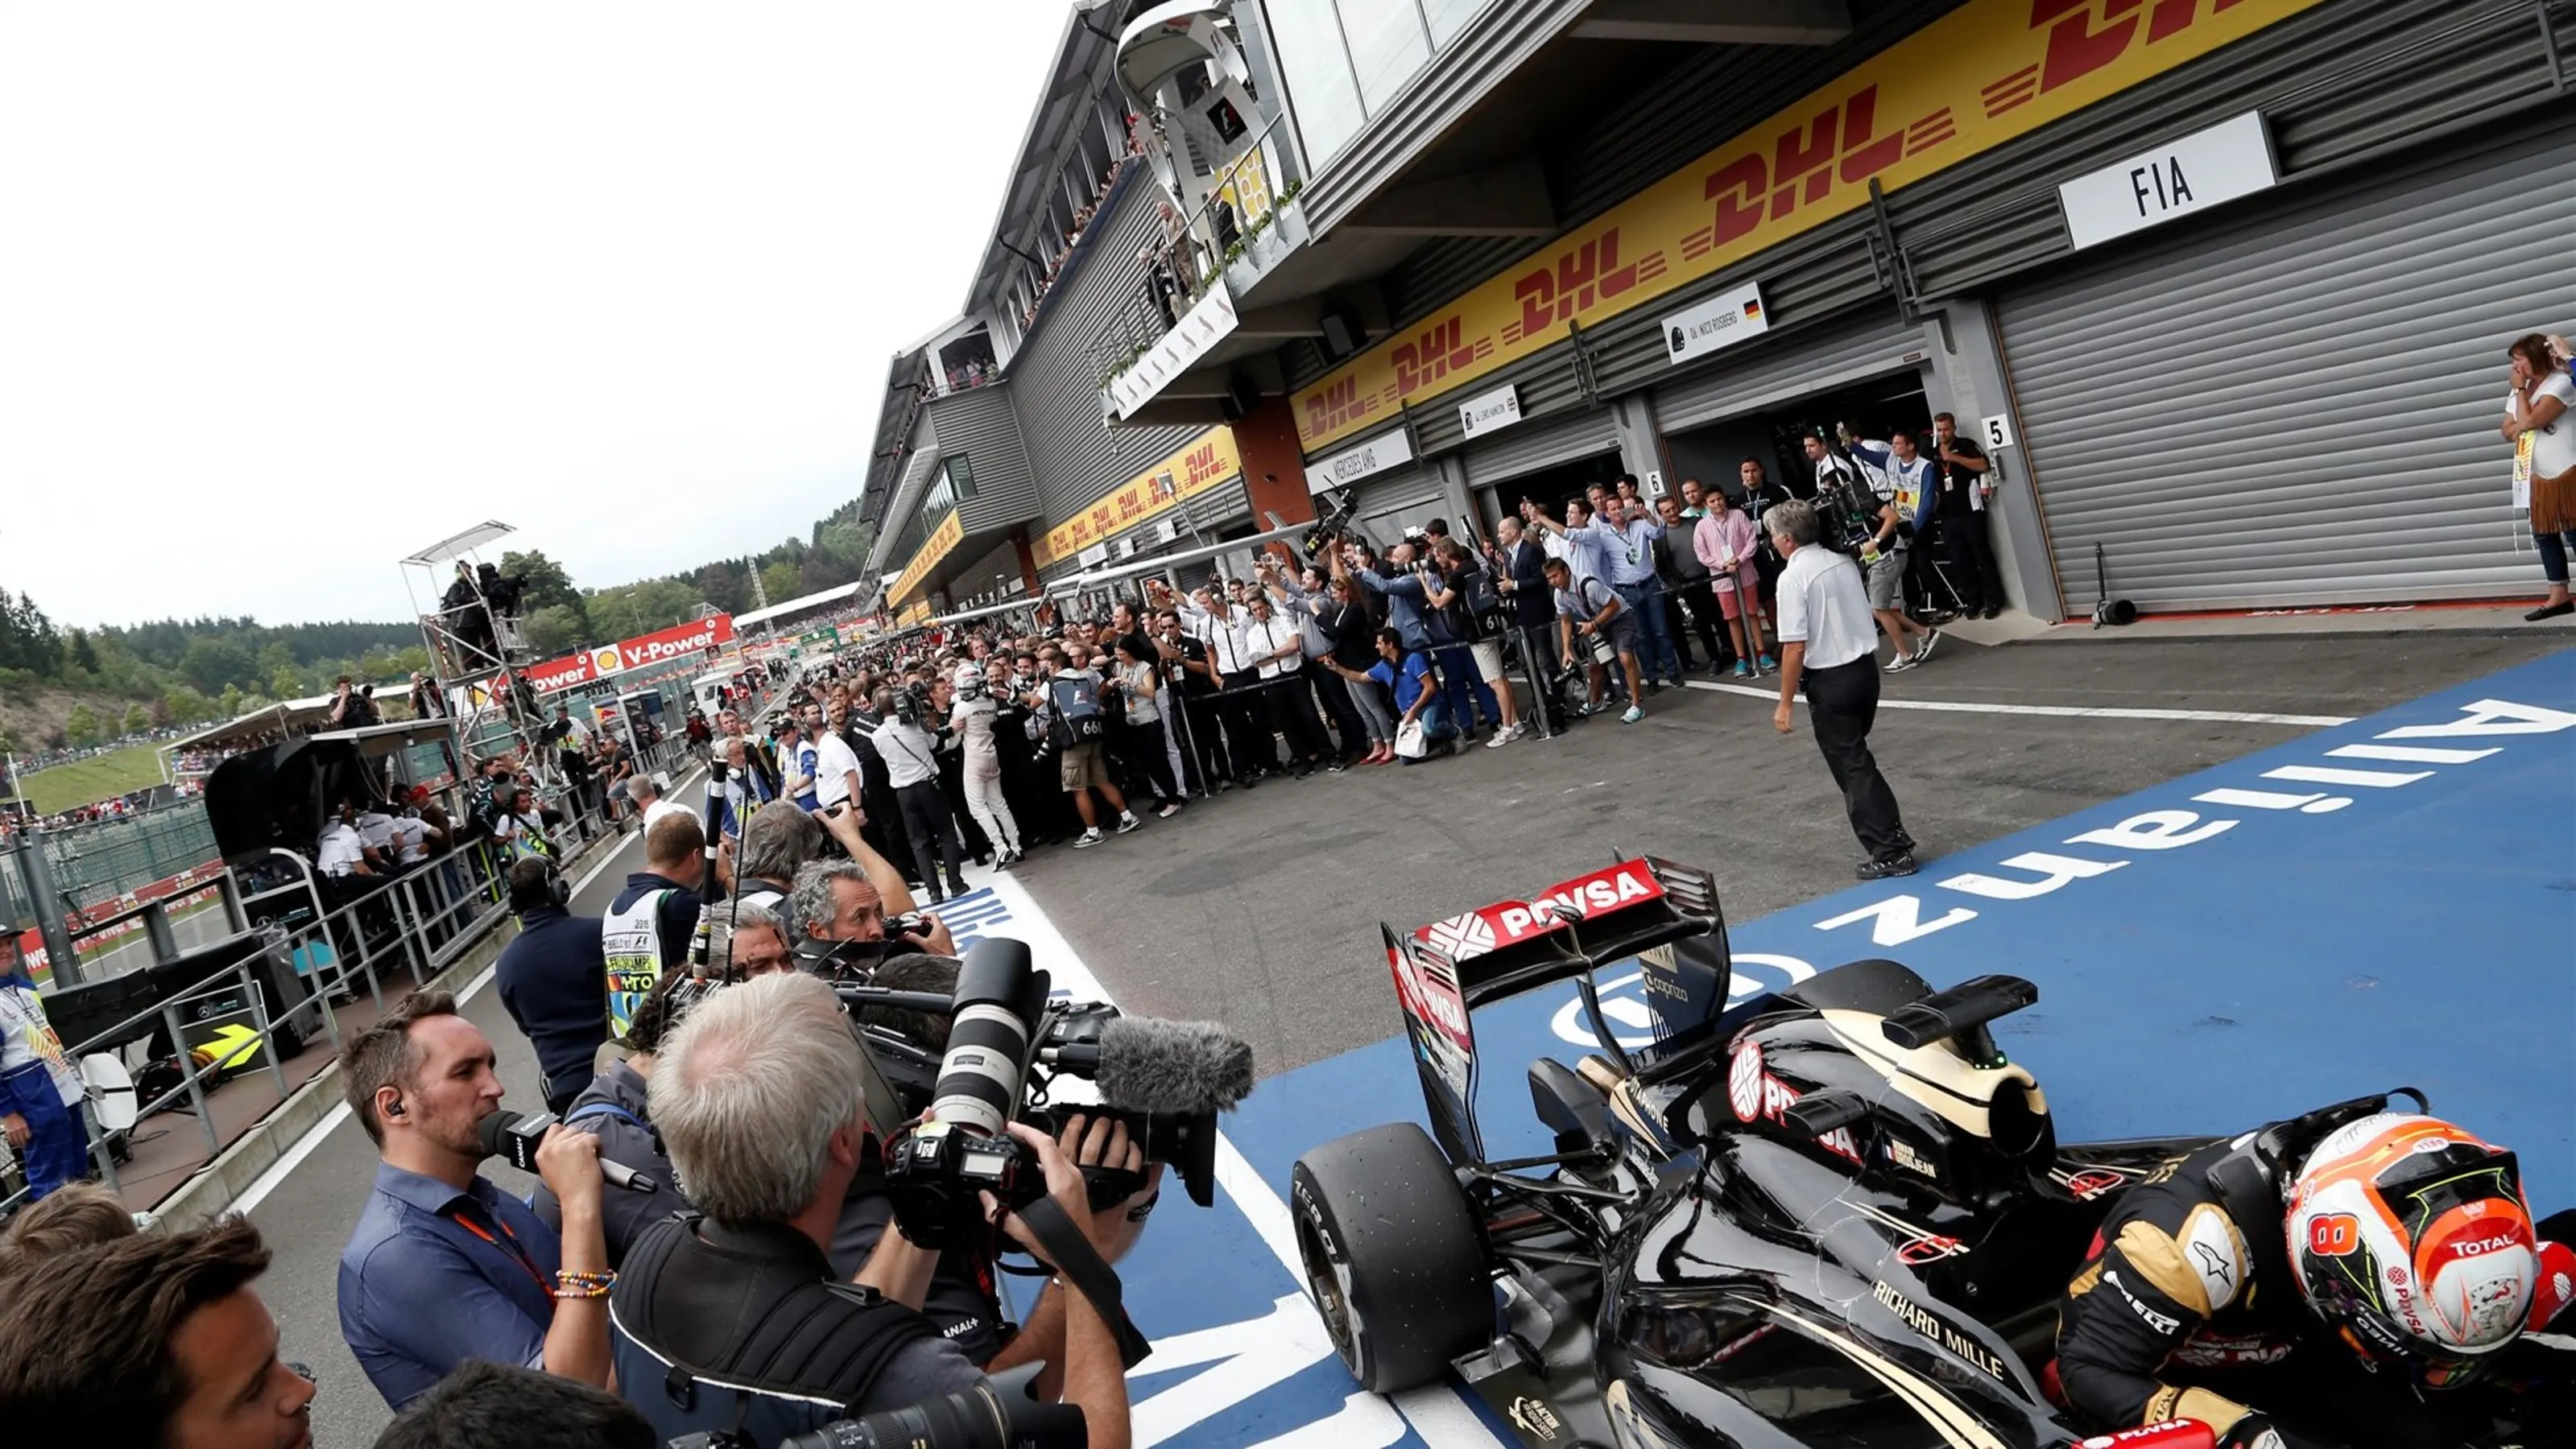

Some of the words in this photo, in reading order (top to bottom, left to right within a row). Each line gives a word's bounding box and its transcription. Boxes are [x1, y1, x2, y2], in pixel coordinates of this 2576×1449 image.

[1705, 84, 1905, 248] DHL
[2131, 156, 2193, 217] FIA
[1515, 227, 1637, 334] DHL
[1698, 320, 1713, 336] NICO
[1391, 315, 1474, 397] DHL
[1305, 374, 1366, 438] DHL
[1991, 420, 2004, 445] 5
[1185, 443, 1221, 486] DHL
[1652, 474, 1659, 492] 6
[1118, 489, 1143, 519] DHL
[625, 630, 715, 666] V-Power
[535, 664, 587, 691] ower
[1813, 698, 2576, 947] Allianz
[1501, 871, 1652, 938] PDVSA
[516, 1136, 526, 1168] CANAL+
[1295, 1179, 1338, 1256] ZERO
[2308, 1212, 2359, 1257] 8
[2450, 1234, 2515, 1257] TOTAL
[944, 1317, 979, 1338] ANAL+
[1873, 1278, 1941, 1340] RICHARD
[1945, 1328, 2005, 1381] MILLE
[2395, 1288, 2426, 1335] PDVSA
[1536, 1406, 1561, 1430] ACTION
